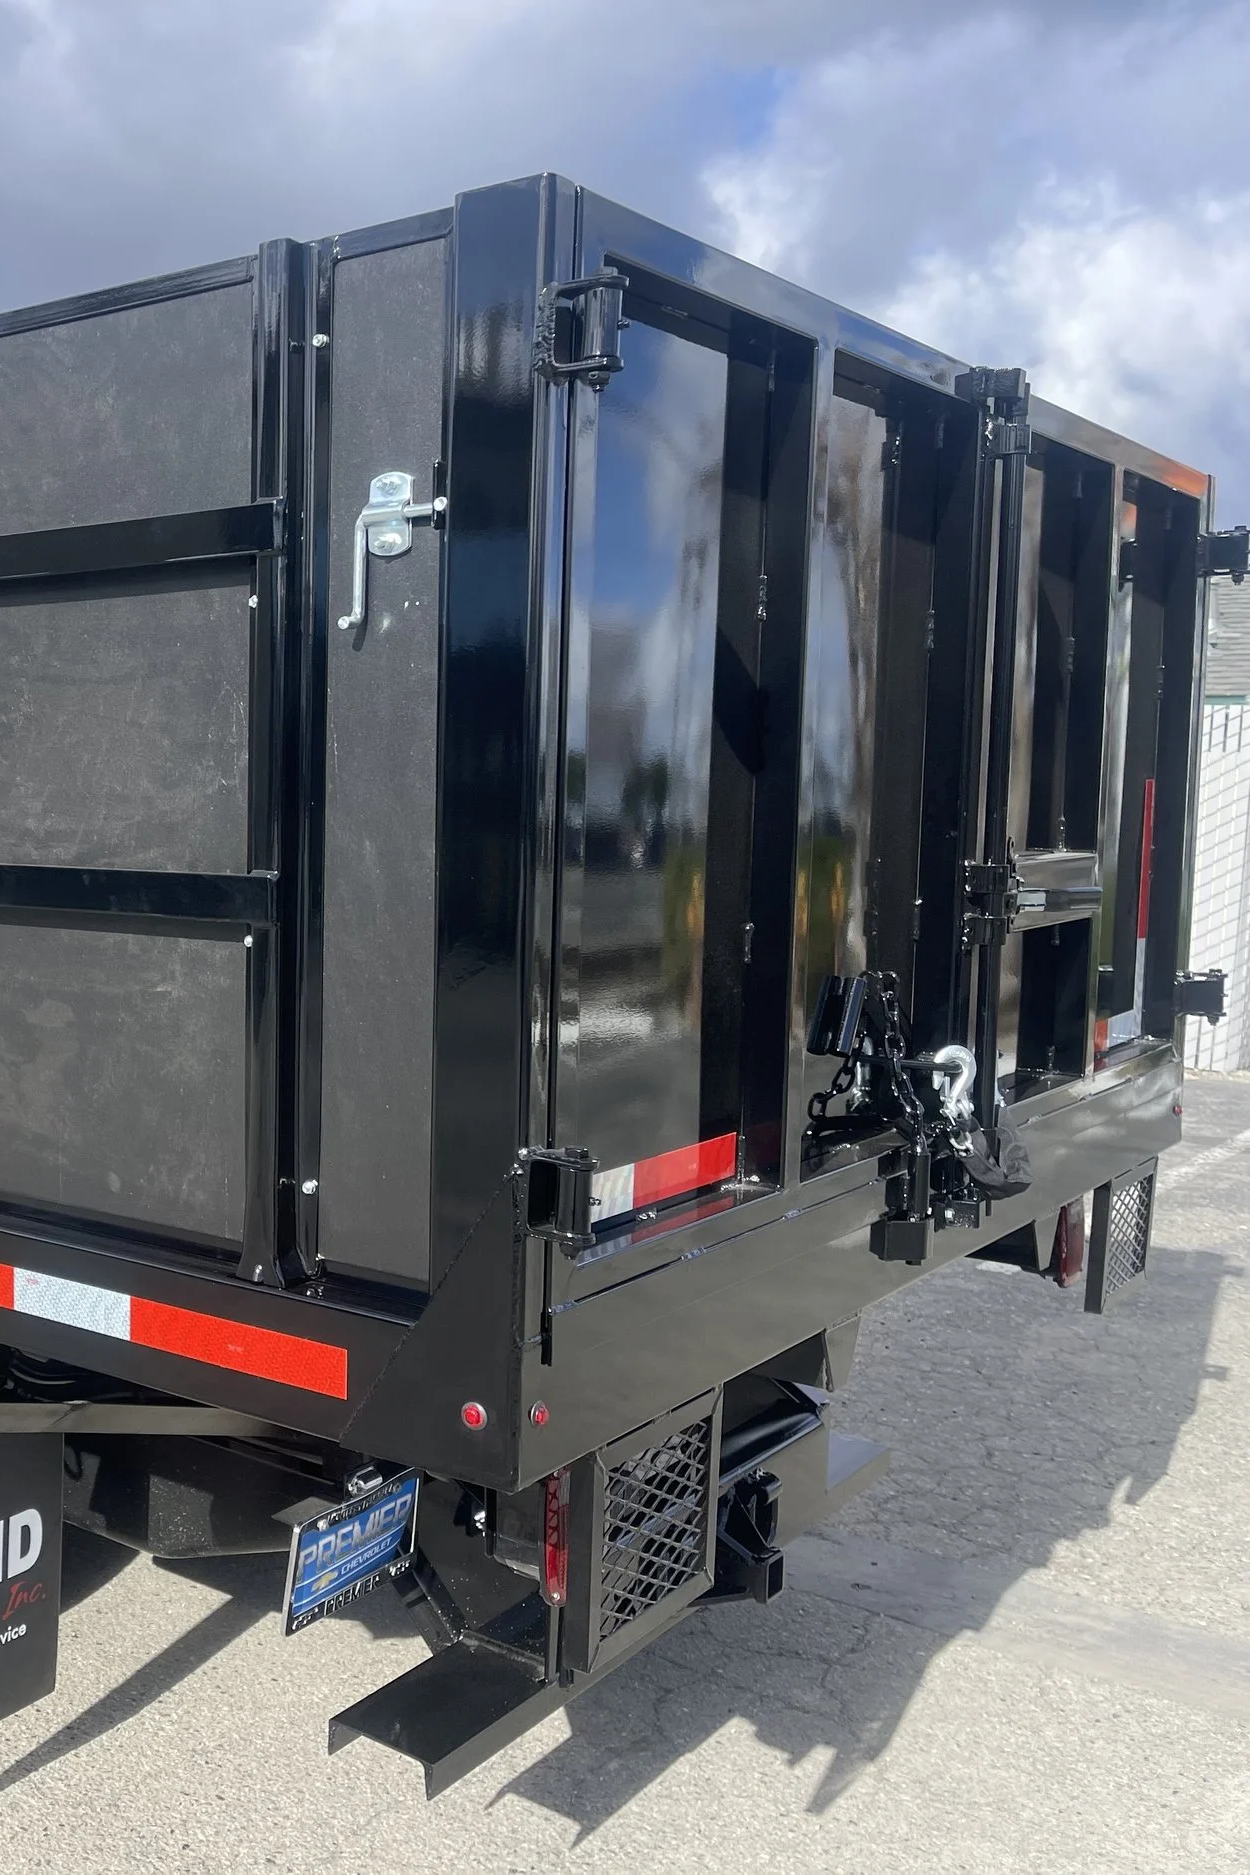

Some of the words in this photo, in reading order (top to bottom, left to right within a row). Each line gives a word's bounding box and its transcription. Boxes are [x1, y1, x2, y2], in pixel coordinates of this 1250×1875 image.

[296, 1493, 412, 1585] PREMIER
[341, 1537, 392, 1574] CHEVROLET
[2, 1580, 47, 1620] Inc.
